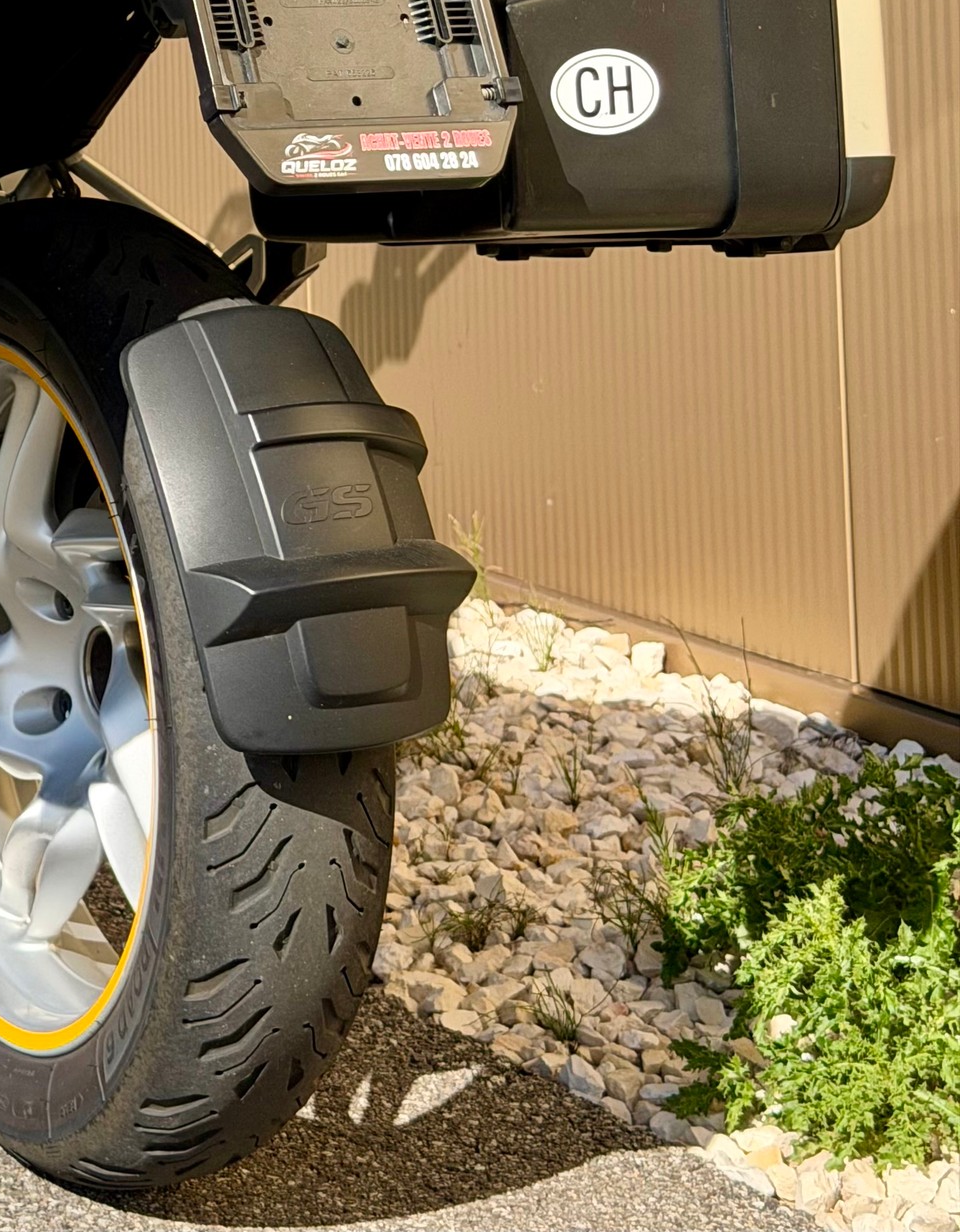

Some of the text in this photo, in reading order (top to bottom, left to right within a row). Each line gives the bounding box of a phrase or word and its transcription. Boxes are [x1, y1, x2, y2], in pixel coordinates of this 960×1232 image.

[575, 65, 634, 118] CH
[281, 159, 357, 174] QUELOZ
[384, 150, 479, 171] 078 604 28 24
[280, 483, 373, 525] GS
